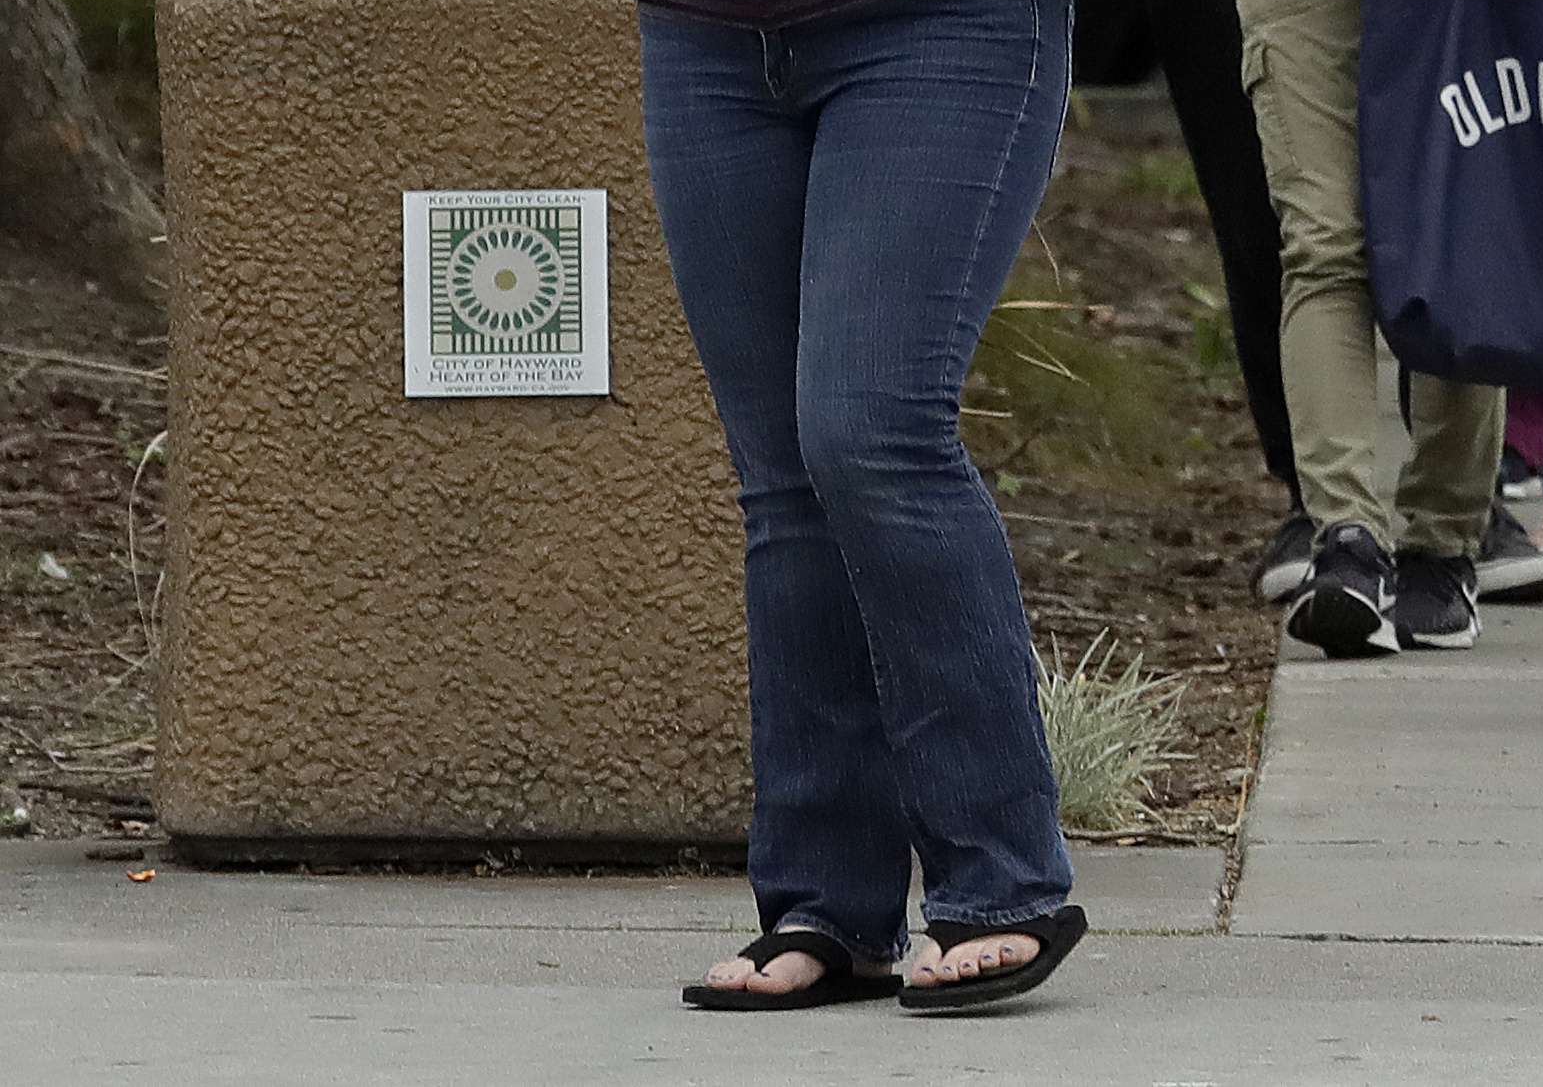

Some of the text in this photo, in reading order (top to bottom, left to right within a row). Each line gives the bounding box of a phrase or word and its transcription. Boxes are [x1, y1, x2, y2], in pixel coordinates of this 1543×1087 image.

[1439, 57, 1532, 147] OLD
[466, 195, 500, 205] YOUR
[504, 194, 532, 205] CITY
[432, 357, 582, 370] CITY OF HAYWARD
[430, 369, 584, 383] HEART OF THE BAY
